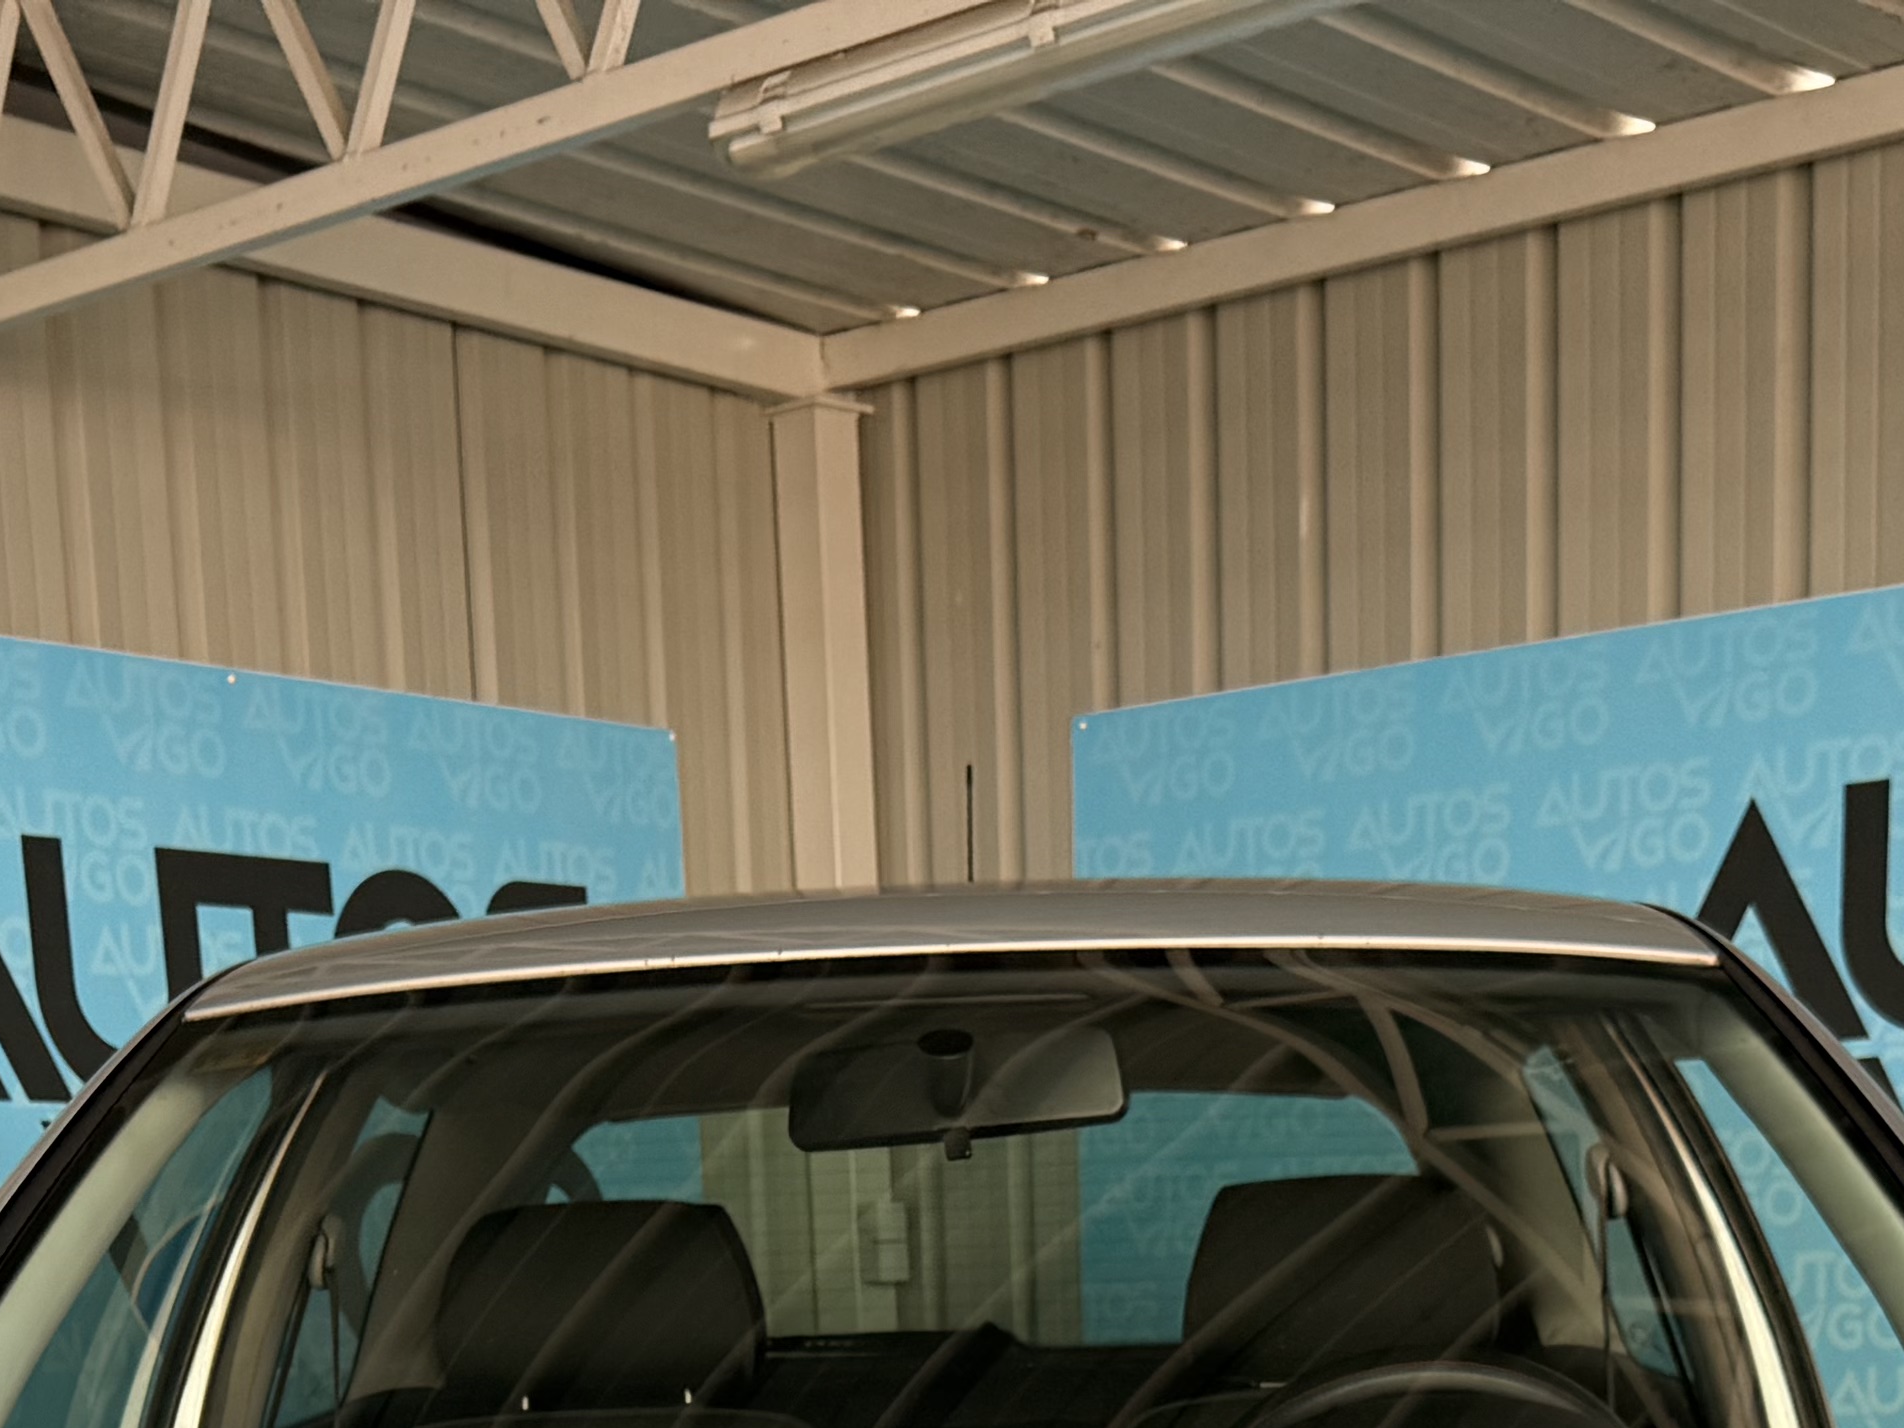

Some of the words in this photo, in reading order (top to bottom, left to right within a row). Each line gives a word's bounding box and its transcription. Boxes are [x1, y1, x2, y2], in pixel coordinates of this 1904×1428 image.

[1344, 780, 1509, 847] AUTOS
[1532, 755, 1709, 825] AUTOS
[337, 822, 473, 878] AUTOS
[491, 837, 615, 890] AUTOS
[1169, 804, 1322, 868] AUTOS
[1569, 811, 1710, 869] VIGO
